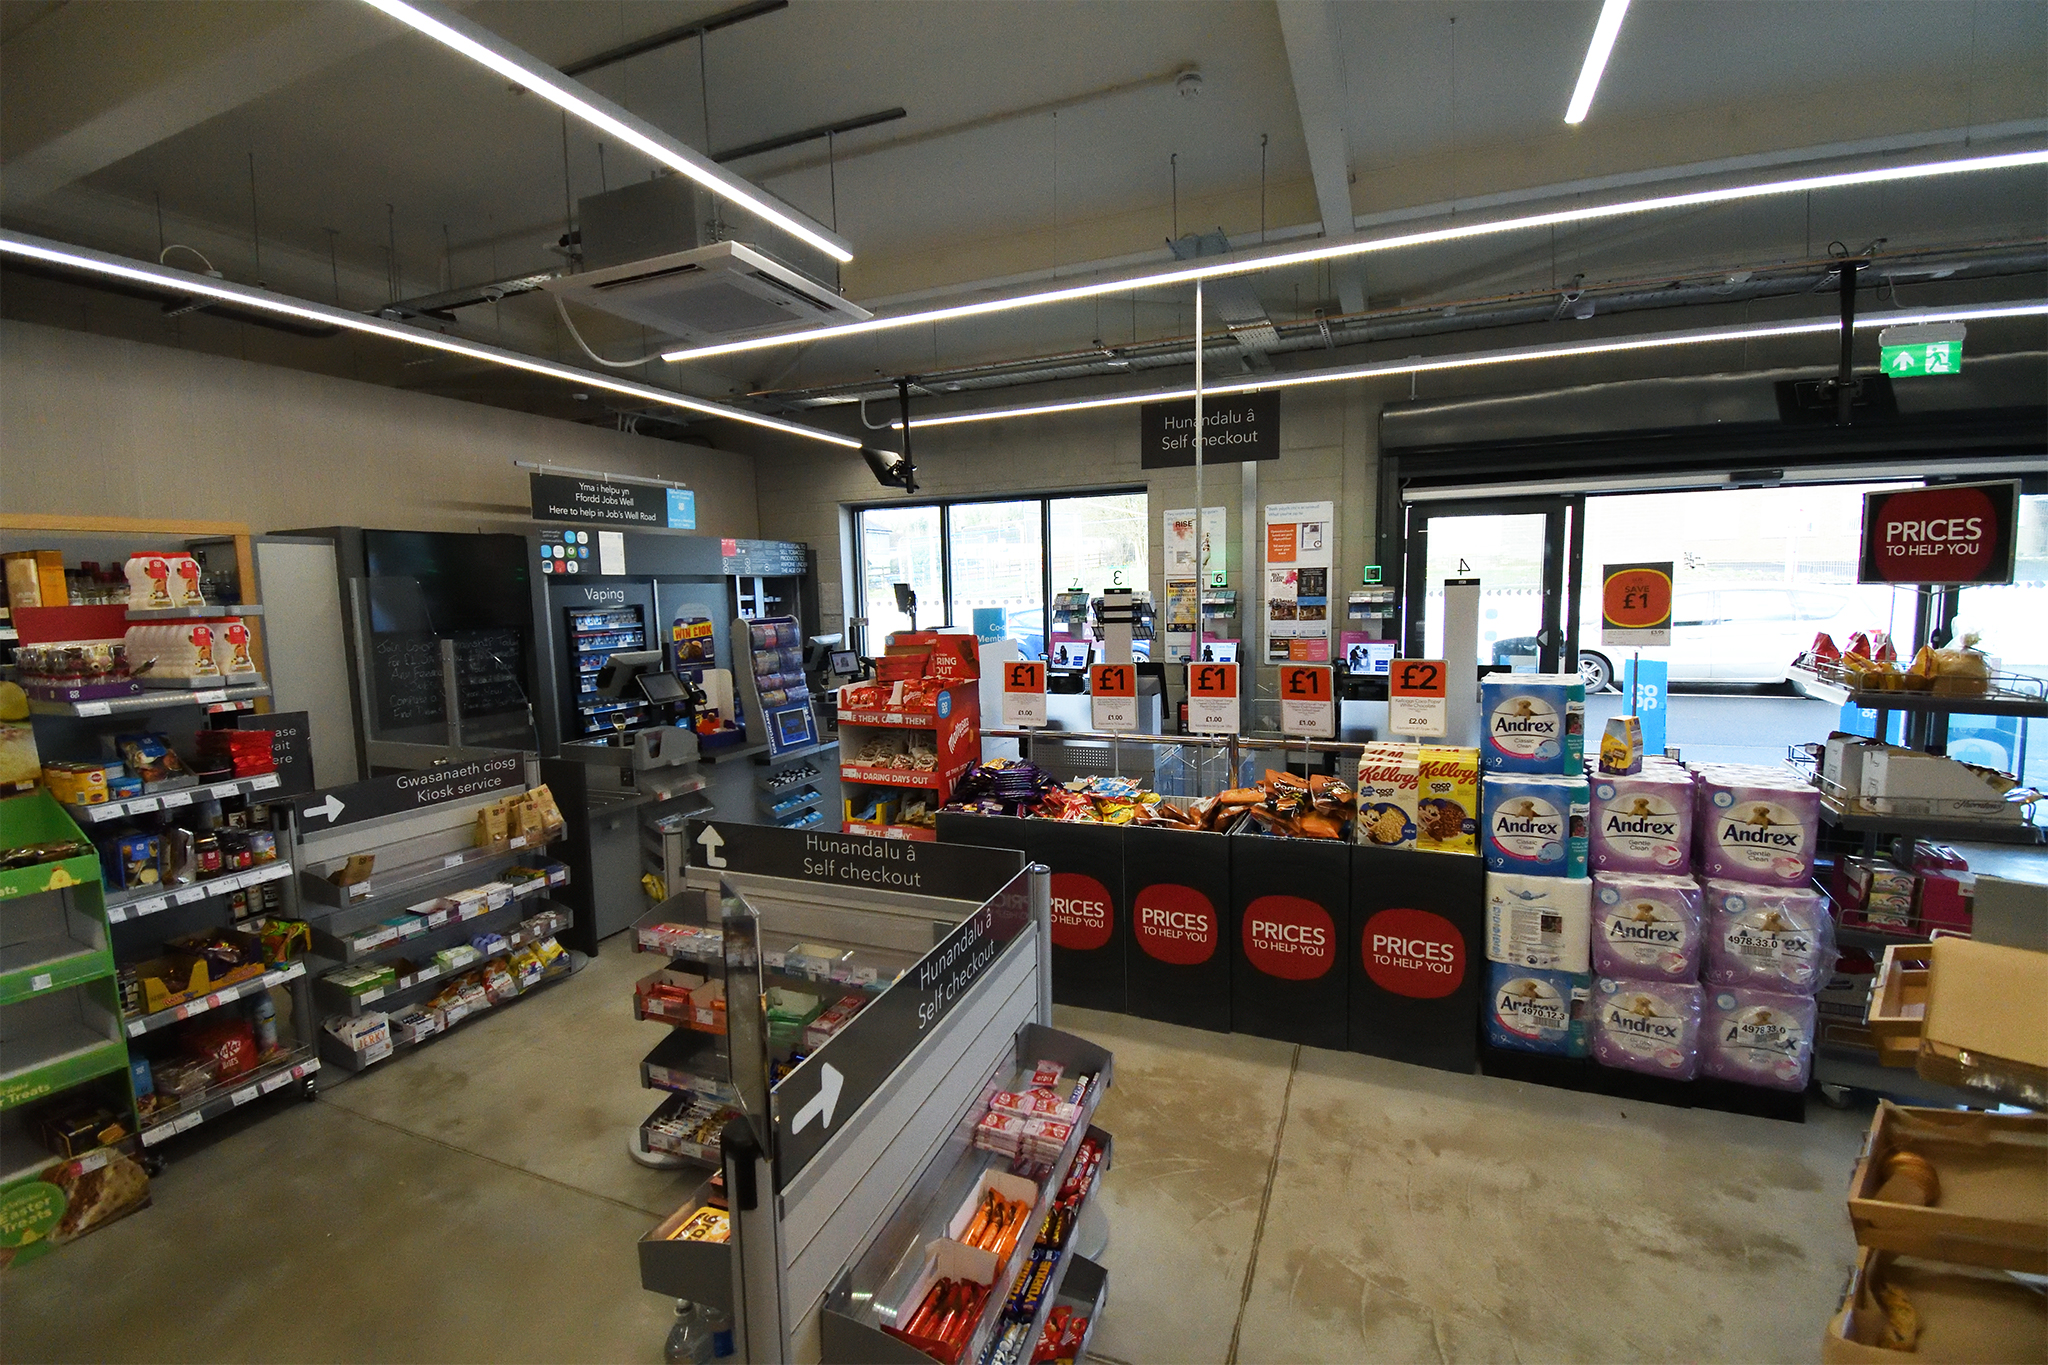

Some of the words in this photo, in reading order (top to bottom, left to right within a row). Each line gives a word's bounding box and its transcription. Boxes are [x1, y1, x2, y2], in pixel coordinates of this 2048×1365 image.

[1246, 408, 1255, 422] â
[1162, 434, 1188, 450] Self
[579, 482, 595, 492] Yma
[596, 483, 600, 492] i
[600, 484, 620, 496] helpu
[621, 488, 630, 496] yn
[575, 493, 600, 504] Ffordd
[601, 495, 619, 505] Jobs
[619, 497, 635, 506] Well
[549, 505, 569, 515] Here
[570, 507, 579, 516] to
[580, 507, 596, 519] help
[597, 509, 605, 518] in
[606, 510, 624, 519] Job's
[624, 511, 640, 520] Well
[640, 512, 657, 522] Road
[1175, 520, 1193, 528] RISE
[1886, 517, 1982, 543] PRICES
[1886, 545, 1906, 556] TO
[1908, 544, 1944, 556] HELP
[1947, 543, 1980, 555] YOU
[1216, 573, 1223, 583] 6
[584, 588, 625, 603] Vaping
[1623, 593, 1649, 609] £1
[674, 628, 691, 641] WIN
[693, 625, 713, 637] £10K
[937, 657, 957, 666] RING
[1011, 665, 1035, 687] £1
[1099, 668, 1125, 690] £1
[1198, 667, 1225, 691] £1
[1289, 669, 1319, 694] £1
[1400, 664, 1438, 690] £2
[858, 714, 880, 724] THEM,
[905, 717, 926, 726] THEM
[1495, 716, 1554, 733] Andrex
[271, 741, 291, 751] ait
[272, 755, 293, 765] ere
[1496, 756, 1503, 765] 9
[396, 762, 480, 789] Gwasanaeth
[484, 758, 516, 773] ciosg
[862, 772, 890, 782] DARING
[892, 774, 911, 783] DAYS
[912, 775, 929, 785] OUT
[418, 785, 455, 803] Kiosk
[458, 778, 502, 794] service
[1274, 782, 1308, 793] Doritos
[1496, 817, 1558, 835] Andrex
[1606, 816, 1675, 835] Andrex
[1722, 824, 1798, 847] Andrex
[806, 834, 900, 860] Hunandalu
[906, 845, 916, 862] â
[1497, 858, 1504, 866] 9
[1599, 854, 1607, 864] 9
[804, 858, 835, 876] Self
[840, 862, 921, 887] checkout
[1714, 864, 1722, 873] 9
[1050, 914, 1058, 923] O
[1059, 916, 1082, 926] HELP
[1084, 918, 1105, 929] YOU
[1142, 908, 1208, 932] PRICES
[1143, 926, 1157, 936] TO
[1159, 928, 1184, 939] HELP
[1185, 932, 1208, 943] YOU
[1252, 920, 1326, 946] PRICES
[1610, 920, 1680, 942] Andrex
[920, 918, 984, 991] Hunandalu
[986, 908, 992, 929] â
[1252, 938, 1269, 950] TO
[1270, 941, 1298, 954] HELP
[1300, 946, 1325, 957] YOU
[1373, 934, 1455, 963] PRICES
[1728, 935, 1778, 949] 4978.33.0
[1373, 954, 1391, 965] TO
[1394, 956, 1423, 970] HELP
[1426, 961, 1453, 975] YOU
[1603, 960, 1611, 968] 9
[1726, 970, 1734, 979] 9
[918, 984, 943, 1030] Self
[946, 938, 995, 1001] checkout
[1522, 1006, 1566, 1021] 4970.12.3
[1610, 1010, 1678, 1038] Andrex
[358, 1029, 387, 1049] JERKY
[1024, 1260, 1053, 1303] YORKIE
